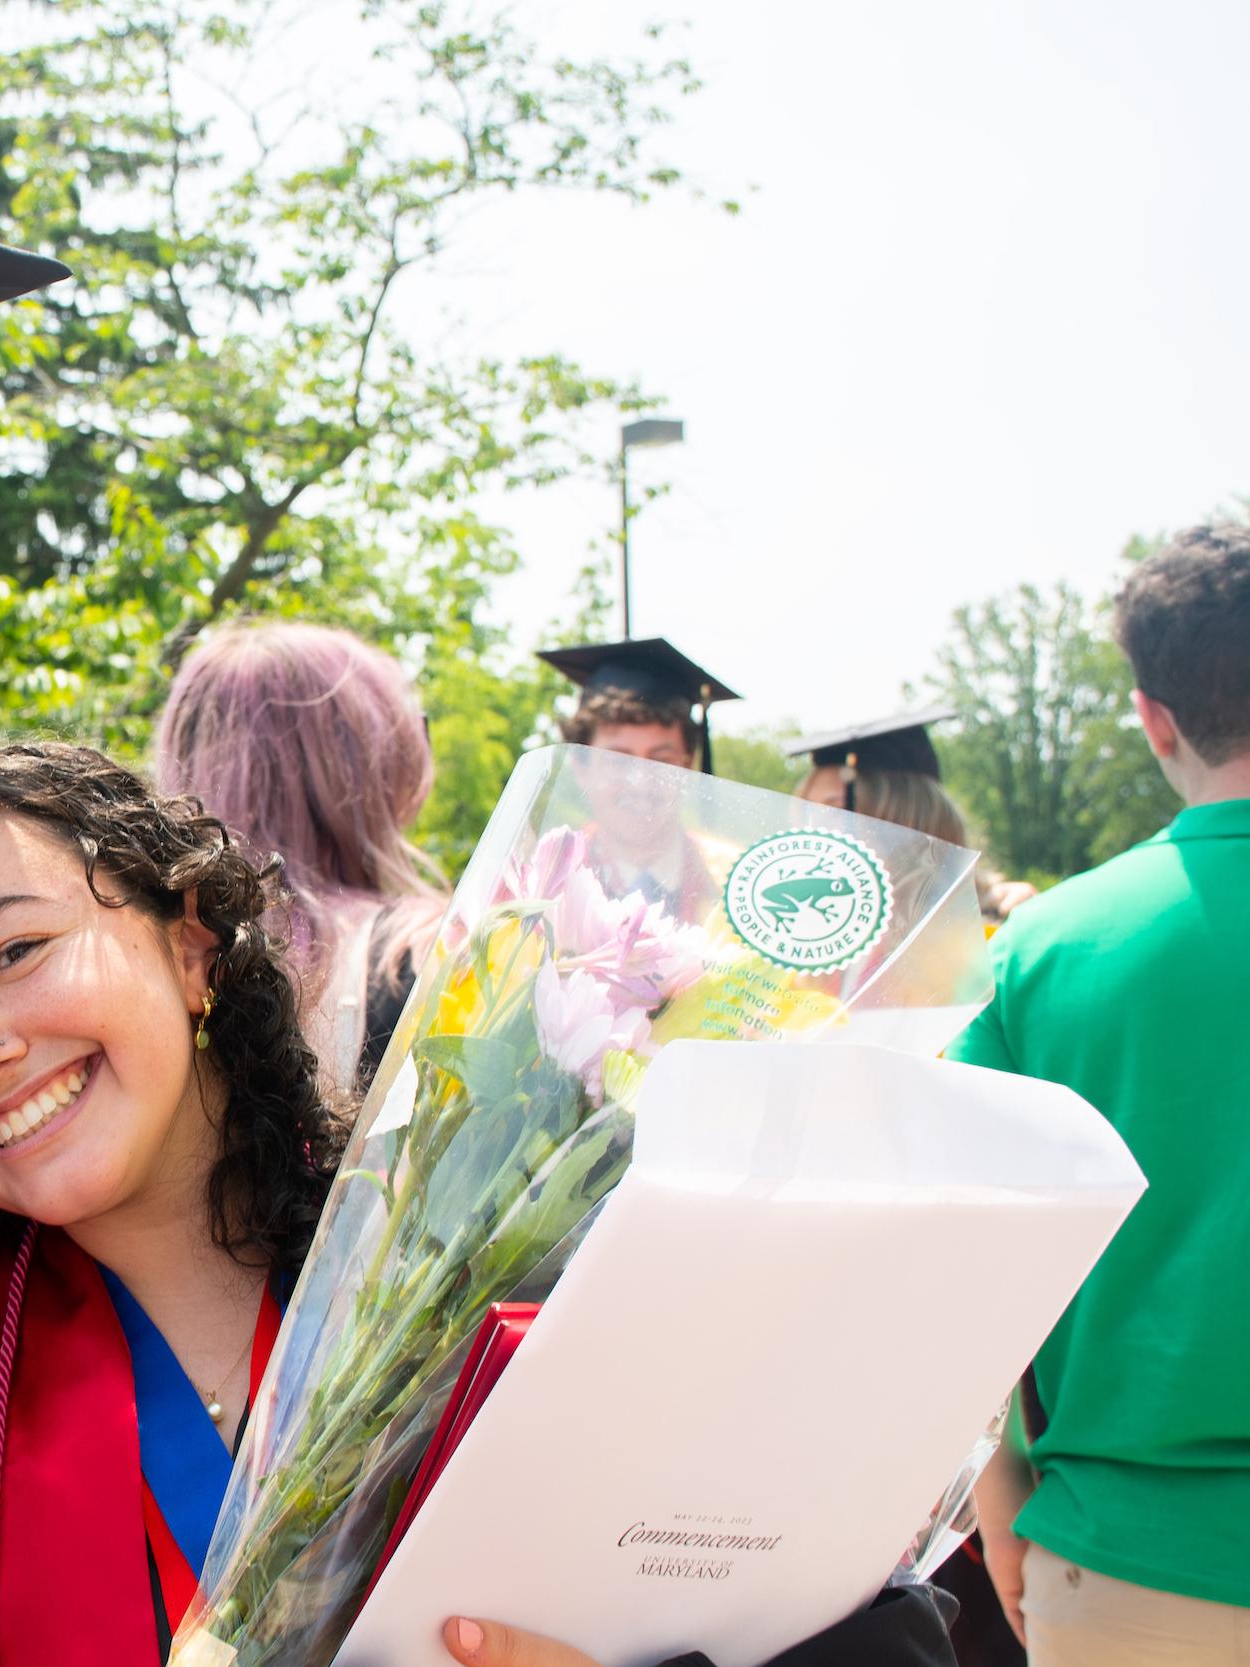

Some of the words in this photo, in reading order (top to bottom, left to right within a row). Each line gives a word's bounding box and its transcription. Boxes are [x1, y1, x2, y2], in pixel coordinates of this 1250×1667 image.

[738, 840, 833, 882] RAINFOREST
[837, 852, 873, 924] ALLIANCE
[735, 896, 773, 945] PEOPLE
[776, 942, 786, 953] &
[791, 933, 854, 959] NATURE
[702, 959, 734, 975] Visit
[617, 1521, 782, 1551] Commencement
[636, 1562, 730, 1579] MARYLAND
[643, 1555, 717, 1567] UNIVERSITY
[720, 1560, 734, 1568] OF
